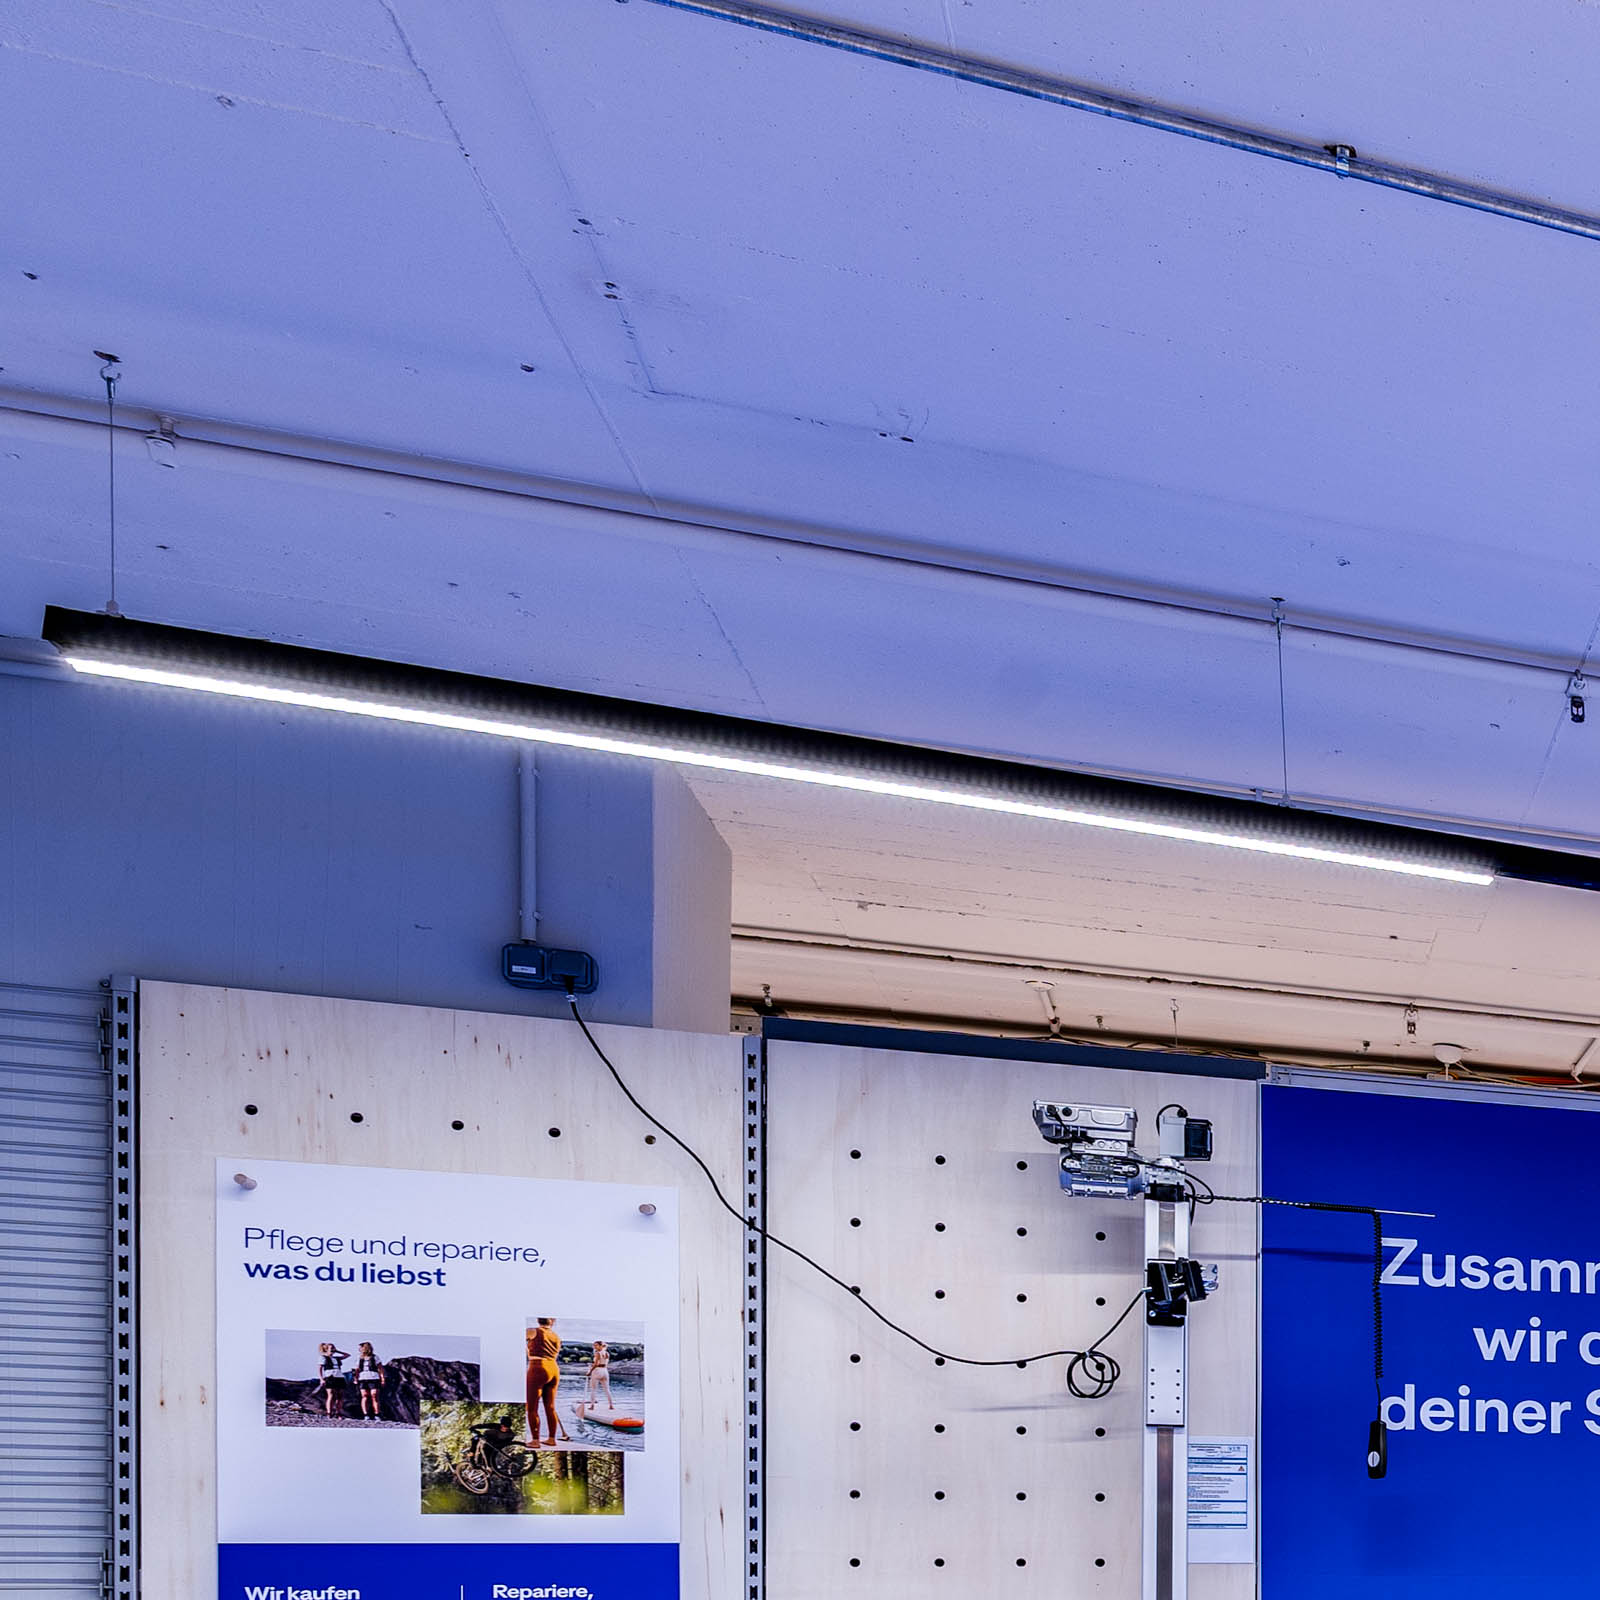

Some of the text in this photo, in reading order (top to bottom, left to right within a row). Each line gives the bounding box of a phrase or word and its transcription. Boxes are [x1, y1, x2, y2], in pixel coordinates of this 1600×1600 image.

[244, 1227, 546, 1267] Pflege und repariere,
[243, 1261, 447, 1287] was du liebst
[1473, 1316, 1567, 1365] wir
[1380, 1384, 1571, 1435] deiner
[287, 1586, 361, 1600] kaufen
[493, 1584, 594, 1600] Repariere,
